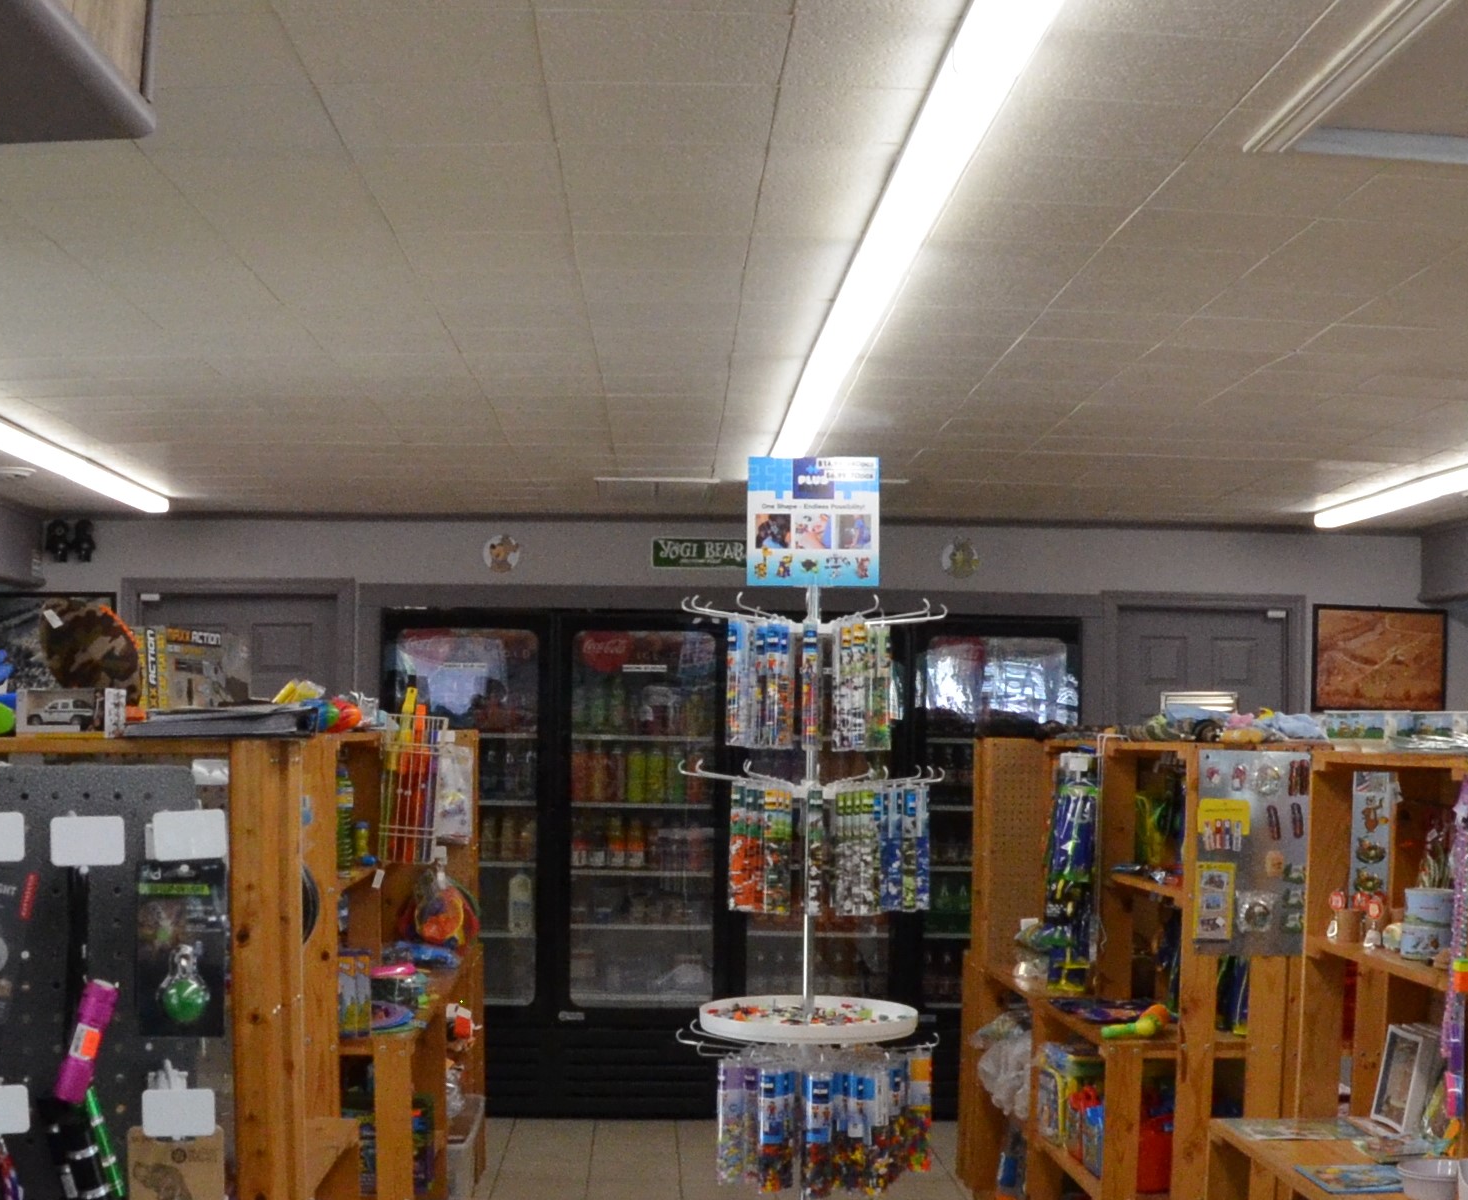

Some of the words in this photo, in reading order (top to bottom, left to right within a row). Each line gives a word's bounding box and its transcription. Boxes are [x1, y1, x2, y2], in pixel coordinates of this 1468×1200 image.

[657, 539, 698, 559] YOGI
[191, 630, 221, 646] ACTION
[146, 628, 157, 685] ACTION
